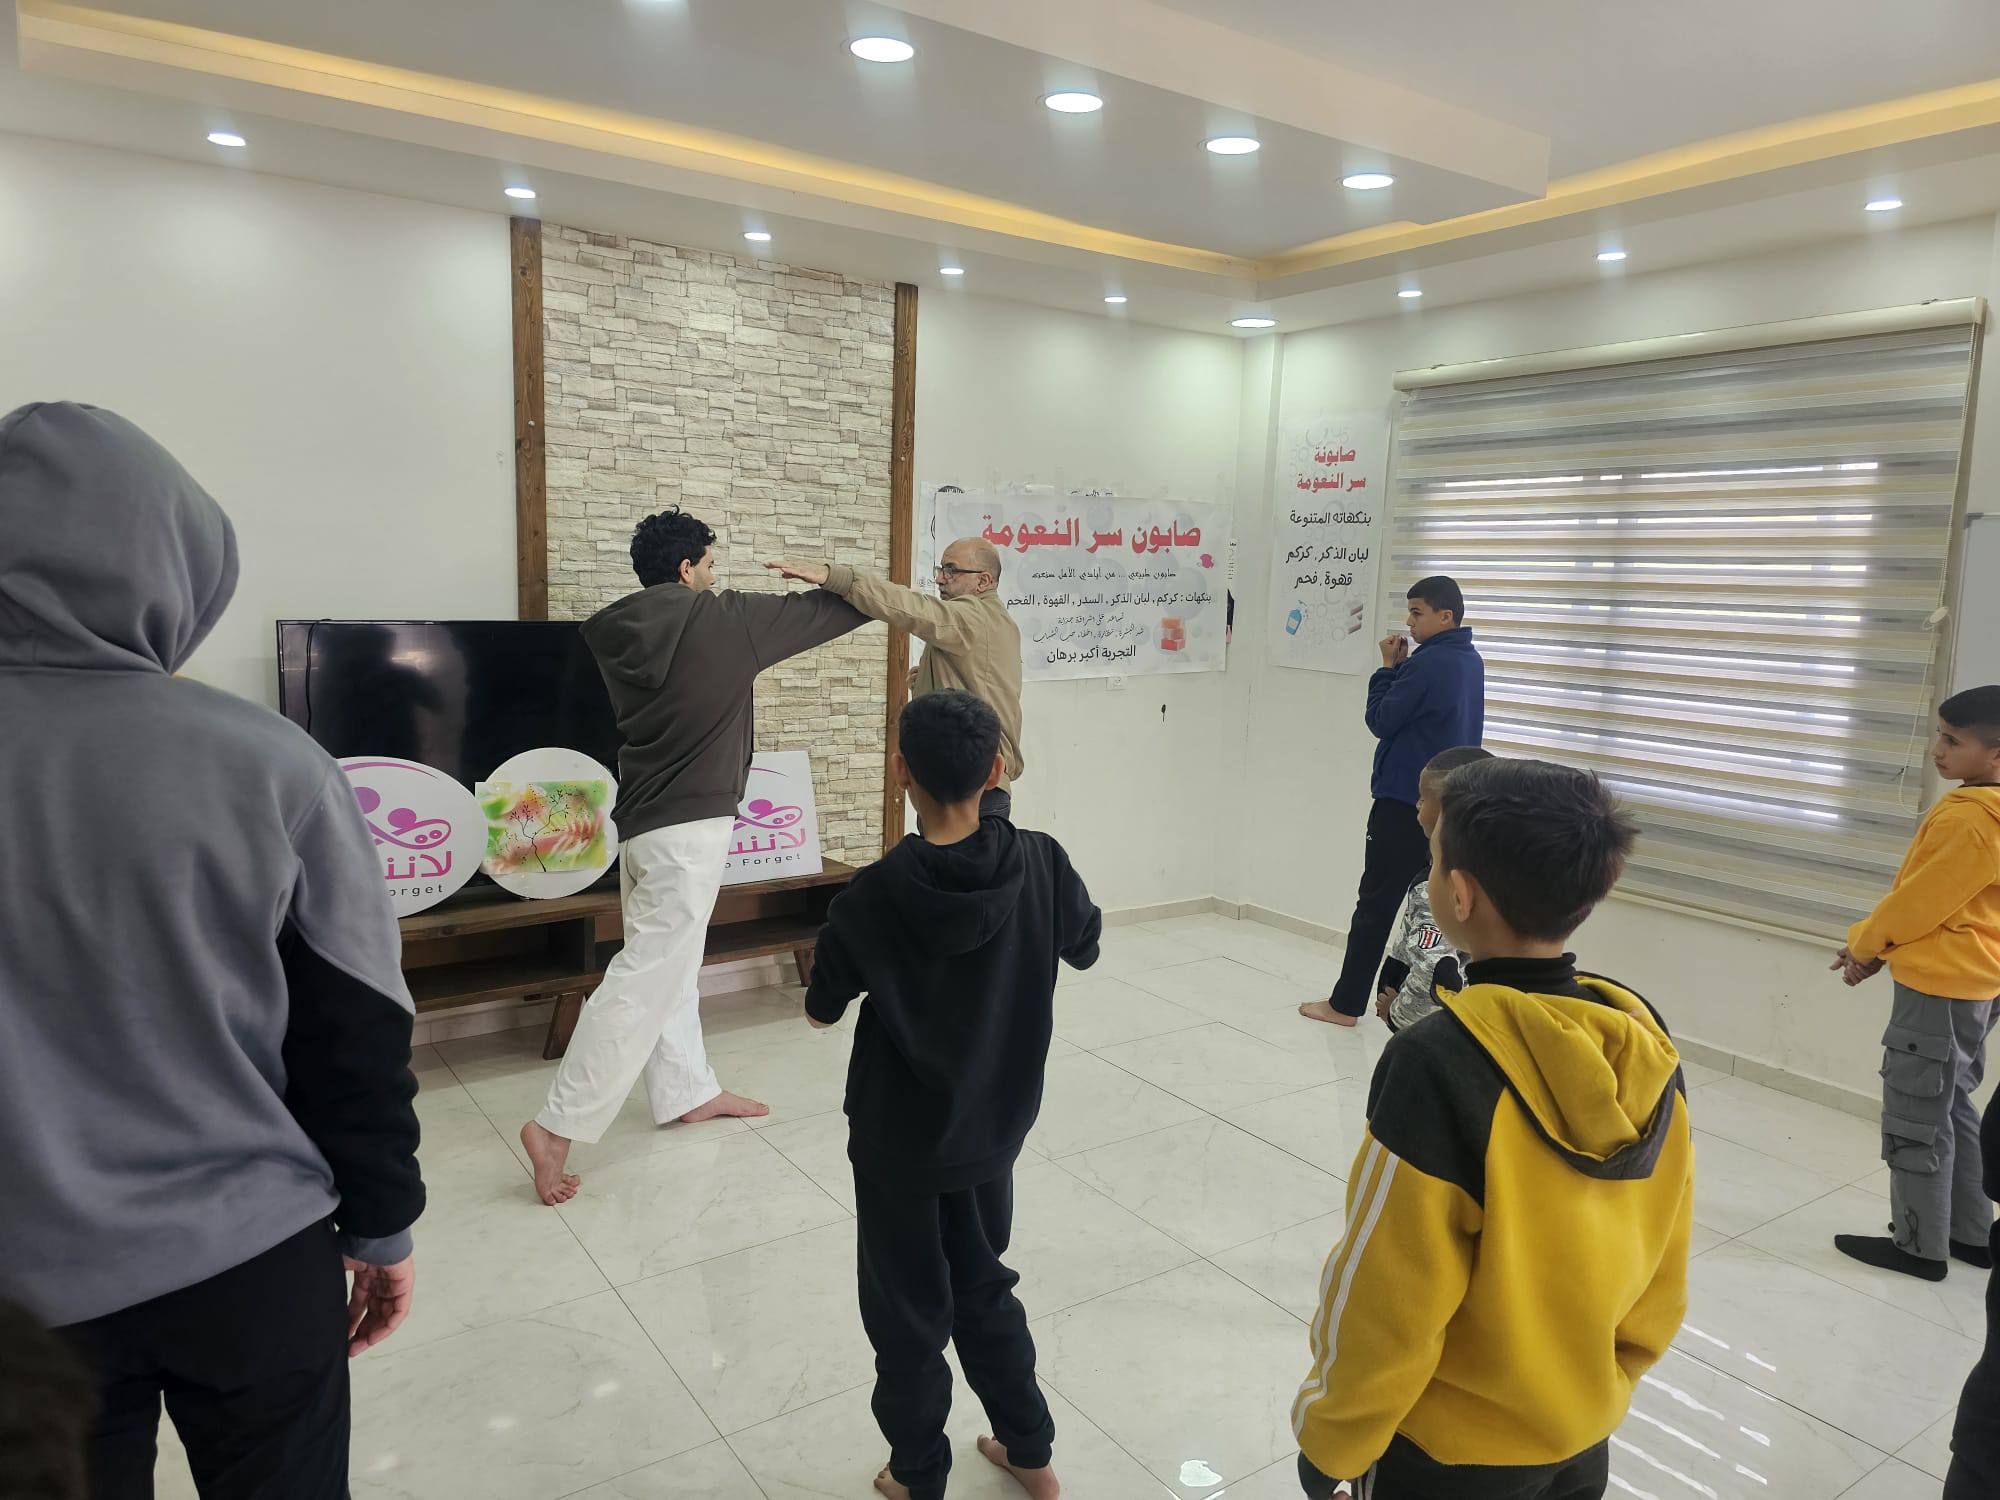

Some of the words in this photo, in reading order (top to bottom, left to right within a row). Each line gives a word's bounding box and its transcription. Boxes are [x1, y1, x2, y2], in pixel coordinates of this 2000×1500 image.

[1314, 446, 1356, 466] صابونة
[1297, 472, 1343, 493] النعومة
[1346, 477, 1366, 492] سر
[1290, 510, 1331, 527] المتنوعة
[1333, 511, 1372, 526] بنكهاته
[982, 514, 1079, 553] النعومة
[1086, 527, 1122, 554] سر
[1131, 520, 1201, 554] صابون
[1286, 546, 1313, 563] كركم
[1349, 547, 1369, 563] لبان
[1294, 571, 1318, 589] فحم
[1007, 594, 1035, 609] الفحم
[1134, 592, 1150, 605] لبان
[1047, 648, 1077, 663] برهان
[1079, 645, 1099, 662] أكبر
[1102, 645, 1136, 660] التجربة
[742, 853, 801, 867] Forget
[389, 884, 445, 897] orget
